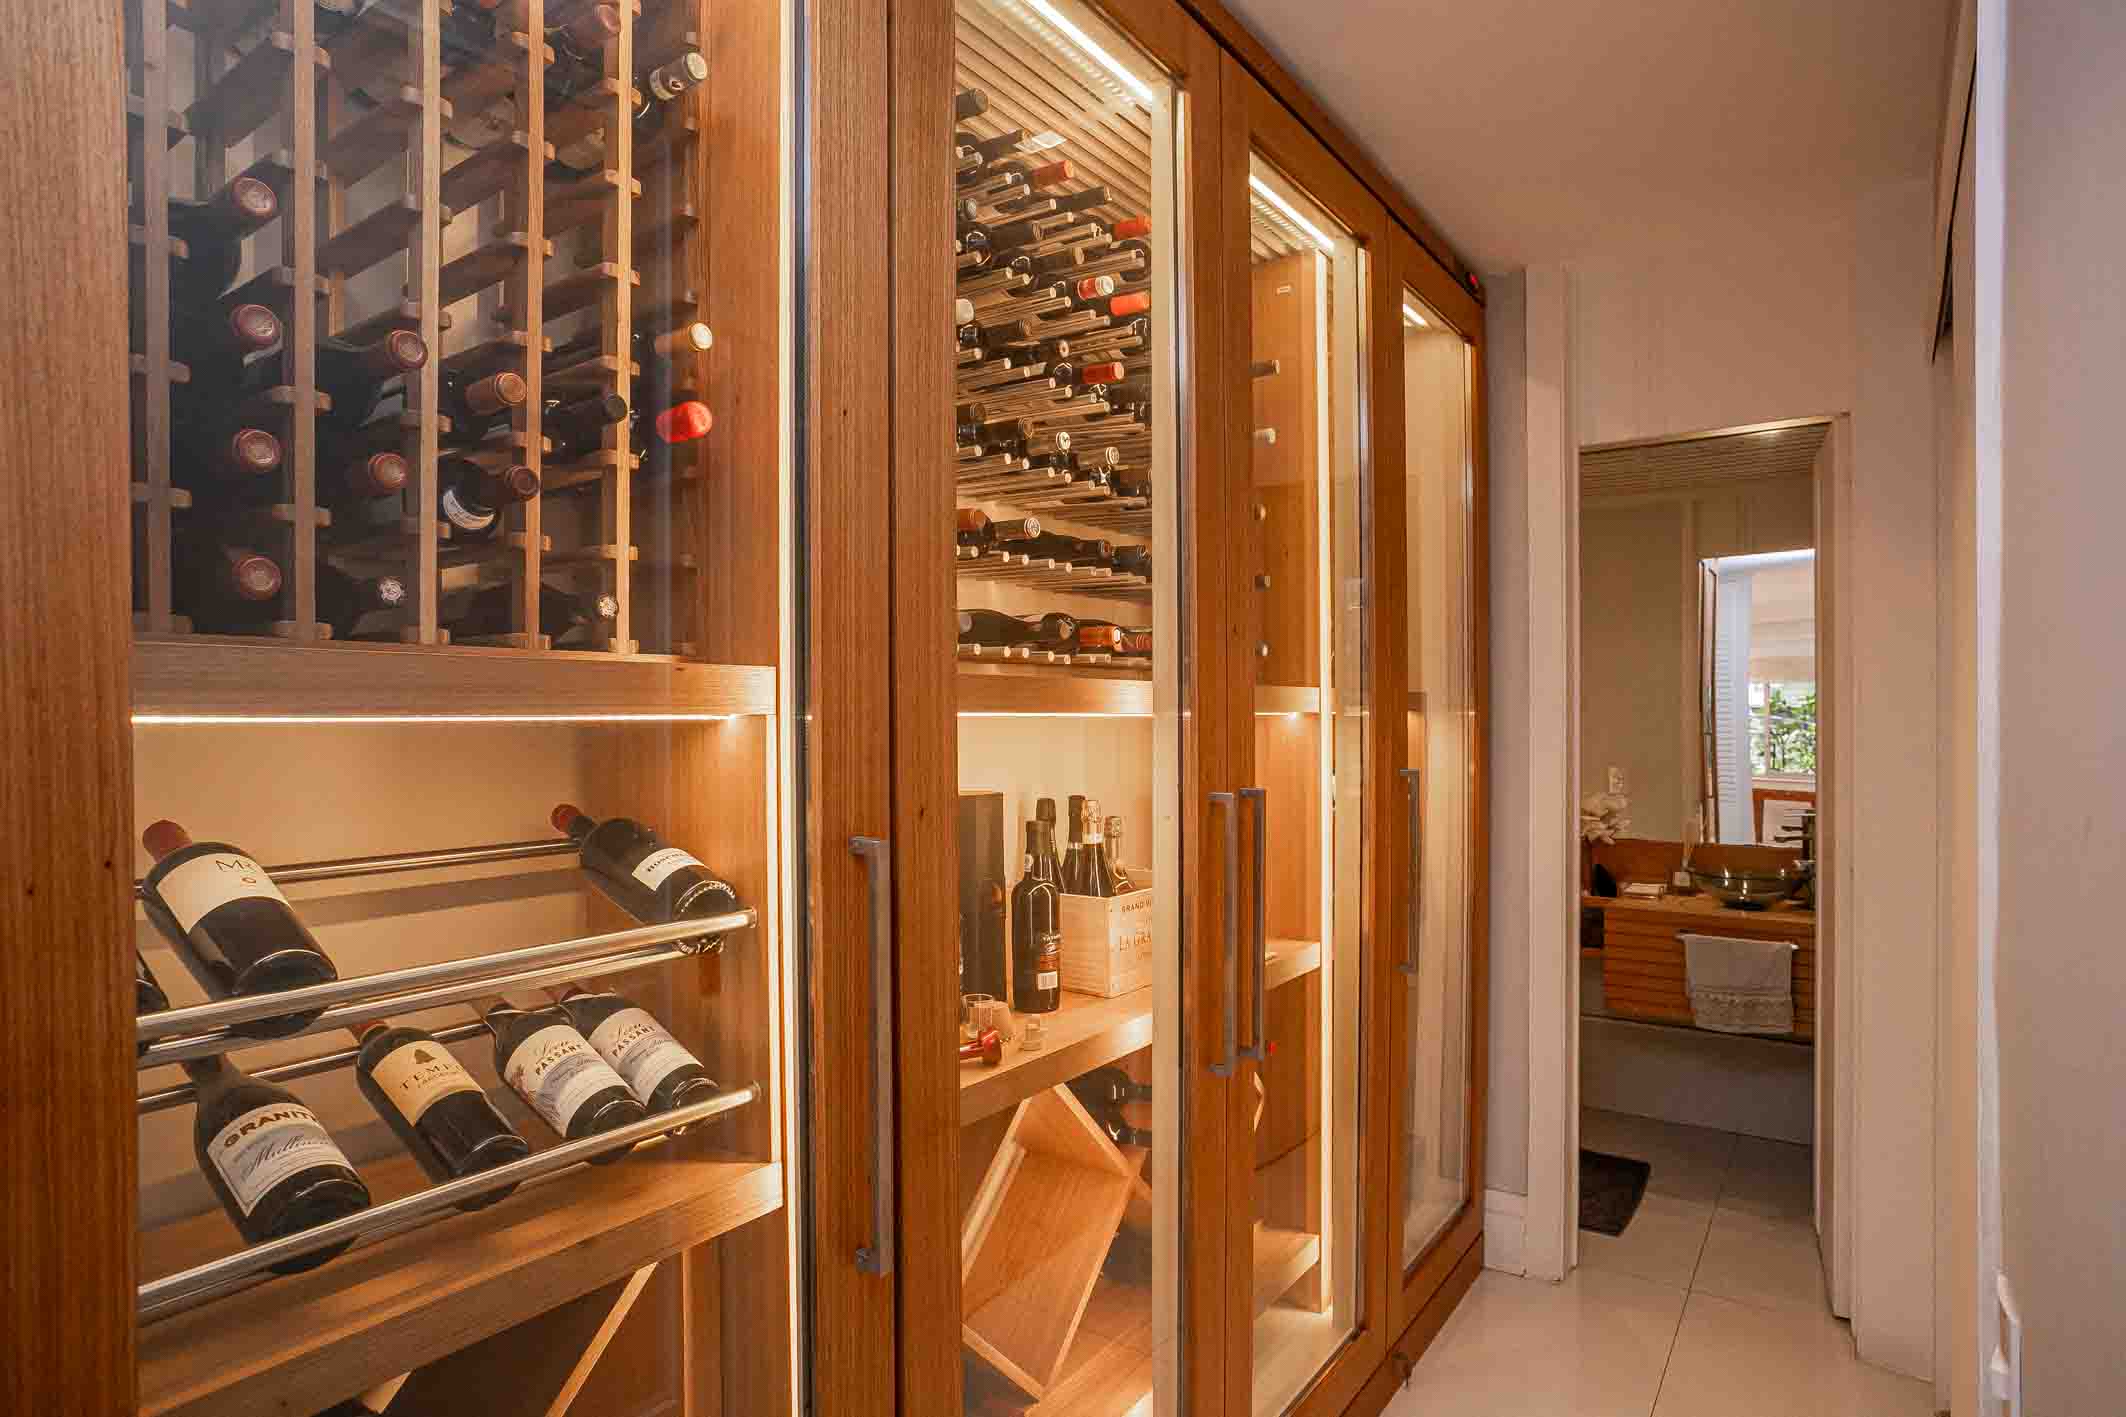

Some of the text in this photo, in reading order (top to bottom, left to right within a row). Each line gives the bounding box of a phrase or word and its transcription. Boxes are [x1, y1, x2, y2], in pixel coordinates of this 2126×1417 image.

[1121, 901, 1144, 913] GRAND
[611, 1025, 656, 1057] PASSANT
[535, 1044, 582, 1077] PASSANT
